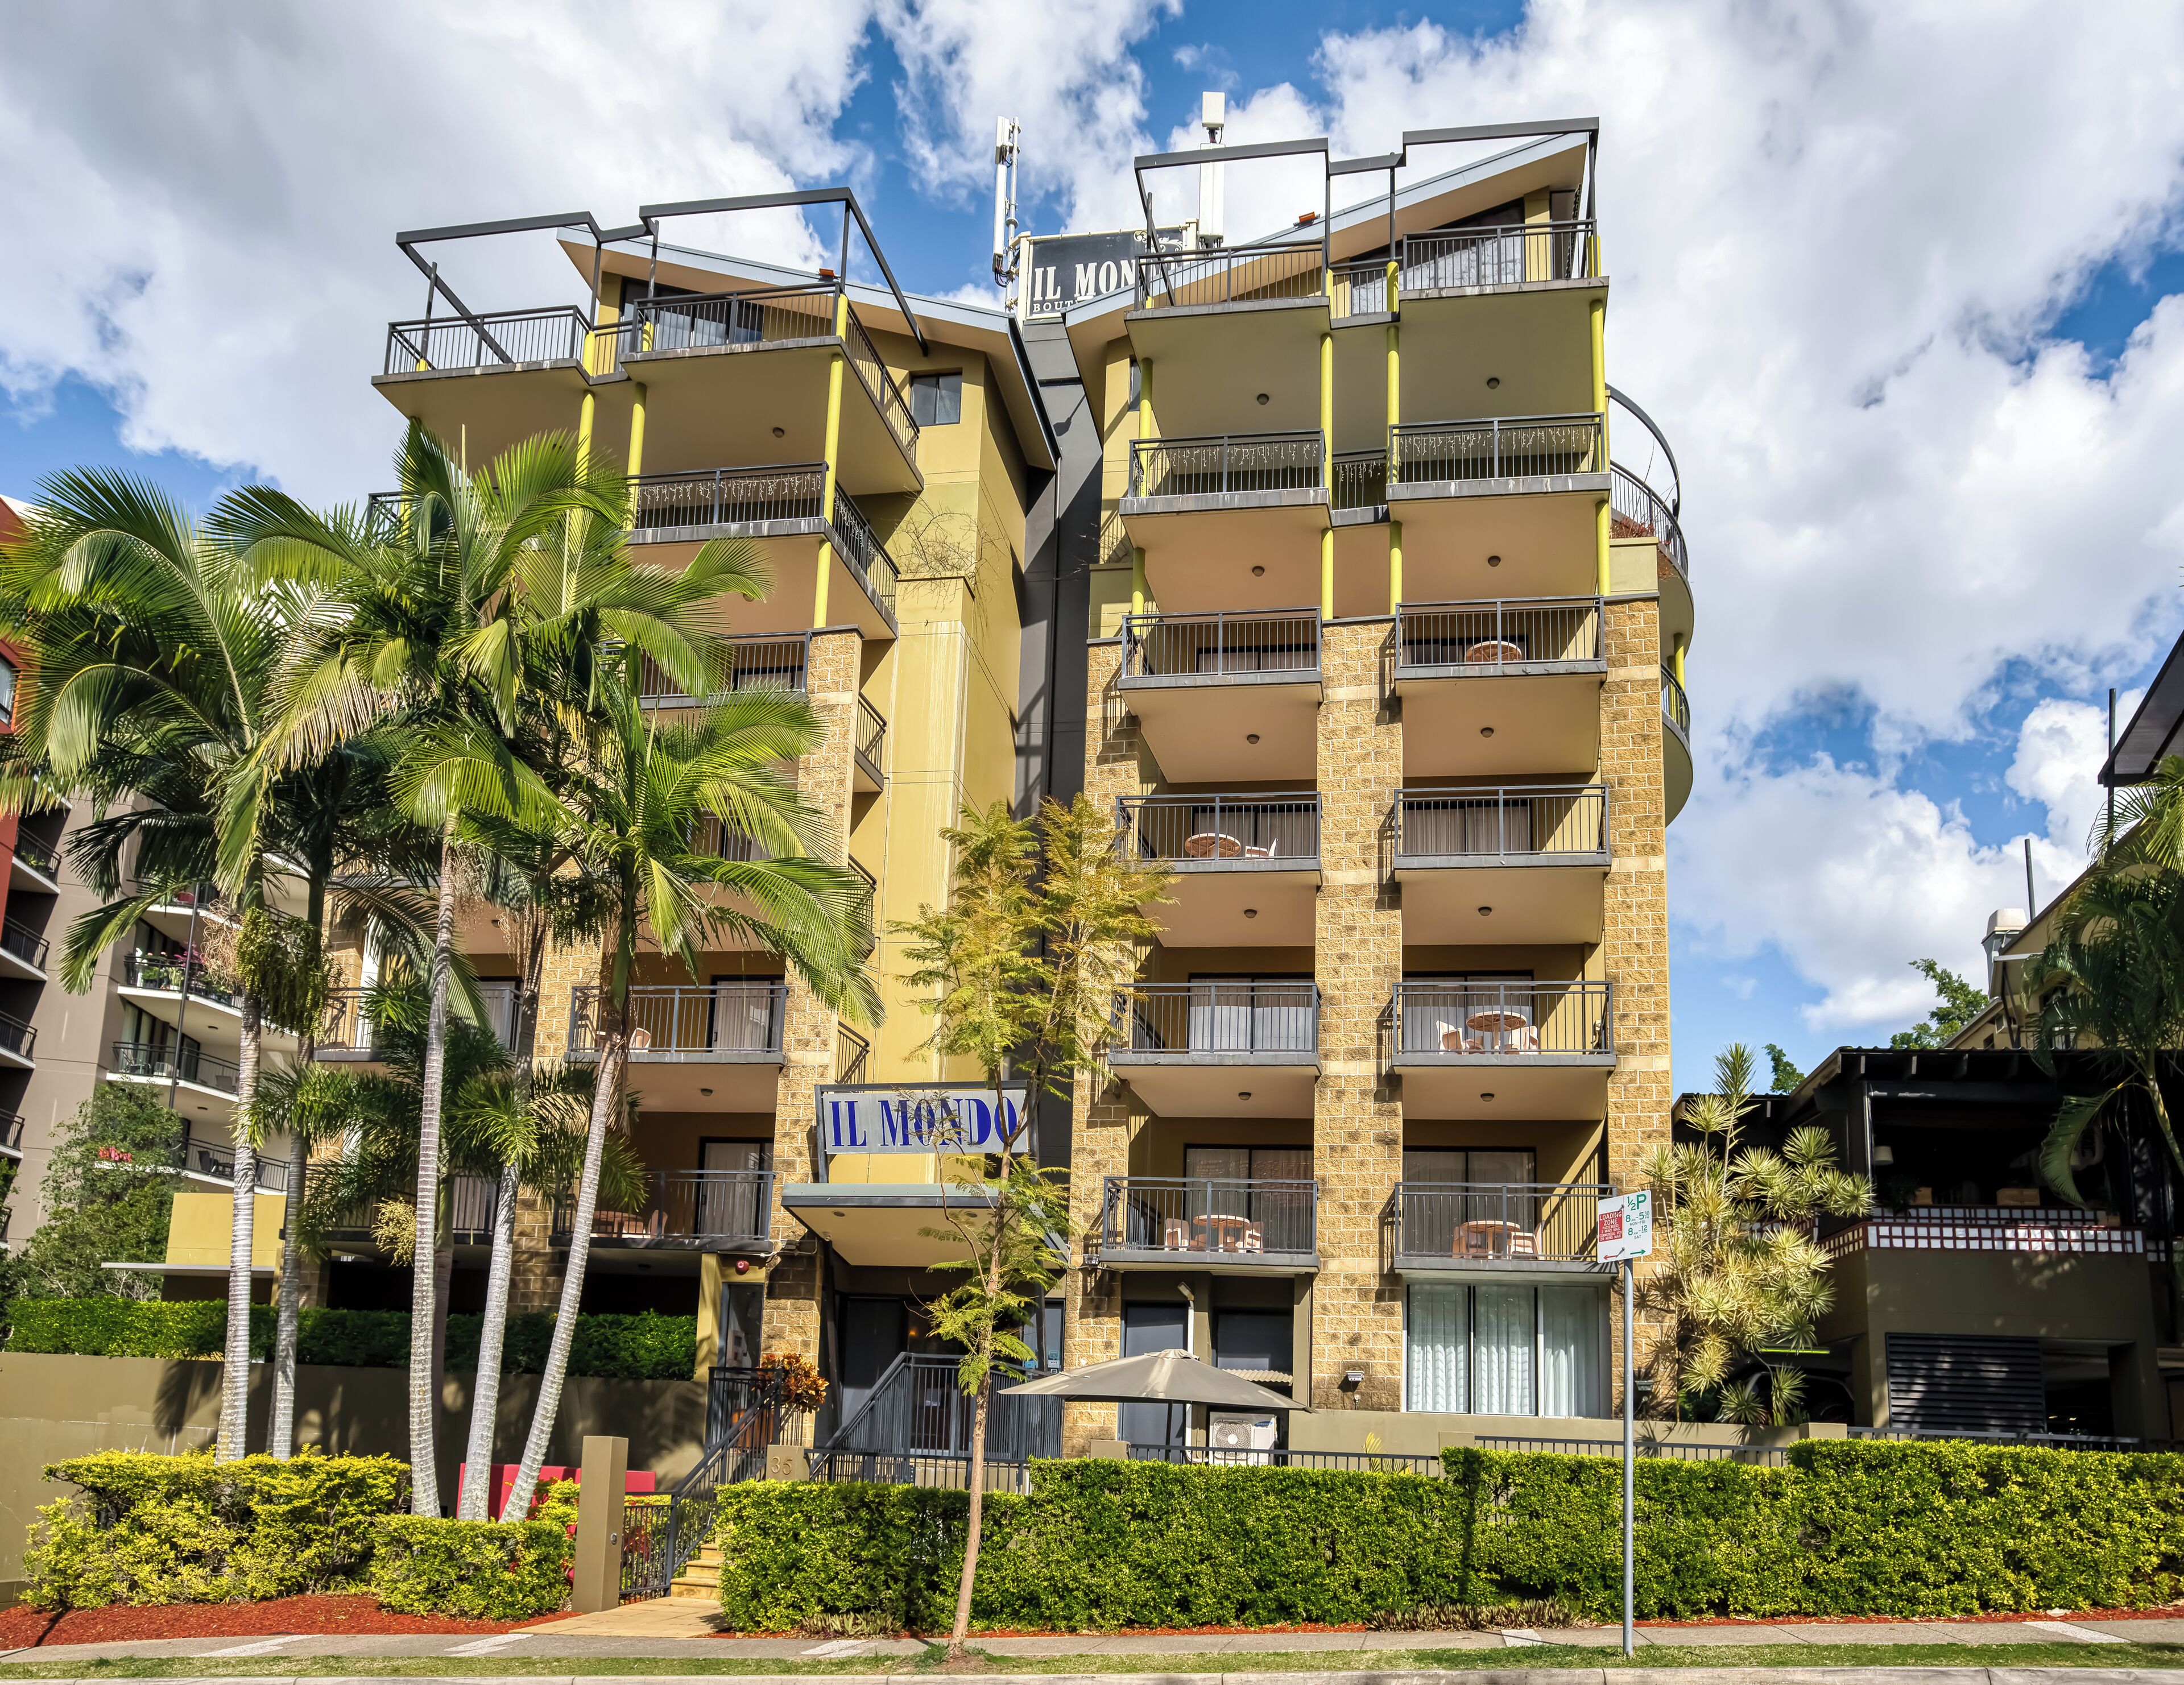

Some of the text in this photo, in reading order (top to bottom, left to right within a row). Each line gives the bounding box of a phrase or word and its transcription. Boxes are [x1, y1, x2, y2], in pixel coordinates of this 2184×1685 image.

[1033, 266, 1061, 301] IL
[828, 1096, 1018, 1147] IL MONDO
[1599, 1211, 1622, 1221] LOADING
[771, 1456, 793, 1475] 35
